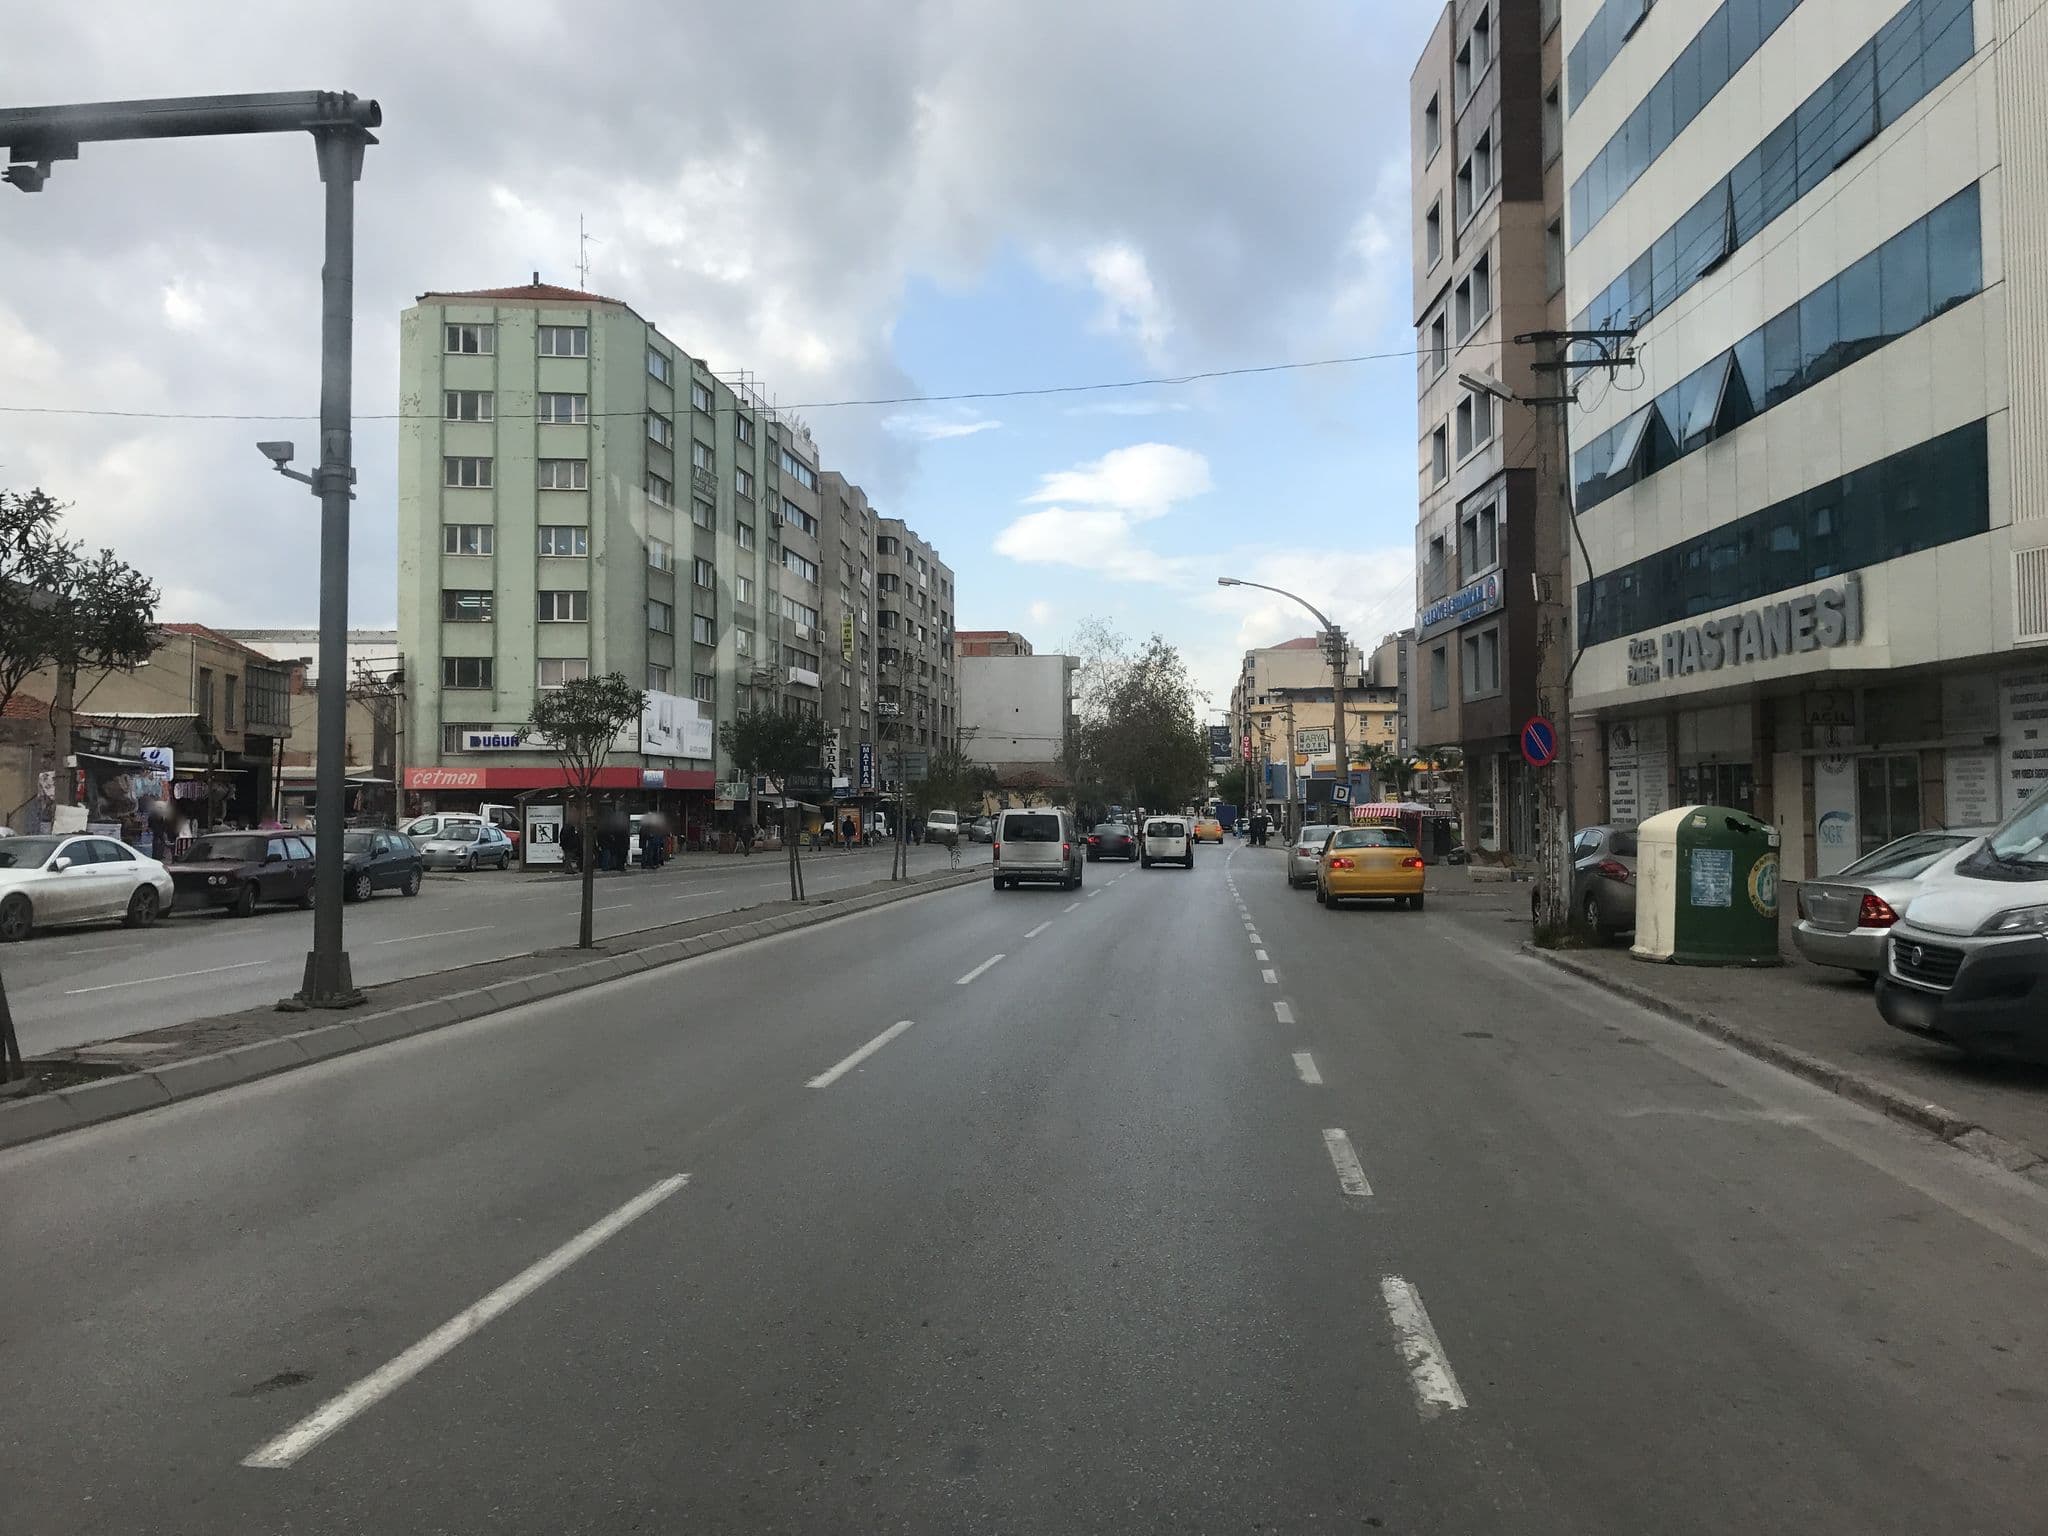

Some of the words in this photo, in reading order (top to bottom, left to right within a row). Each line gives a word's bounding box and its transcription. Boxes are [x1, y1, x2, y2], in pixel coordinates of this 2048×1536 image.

[1661, 576, 1863, 678] HASTANESİ
[1628, 638, 1658, 661] ÖZEL
[862, 746, 870, 784] MATBAA
[412, 769, 478, 787] çetmen
[1336, 787, 1346, 799] D
